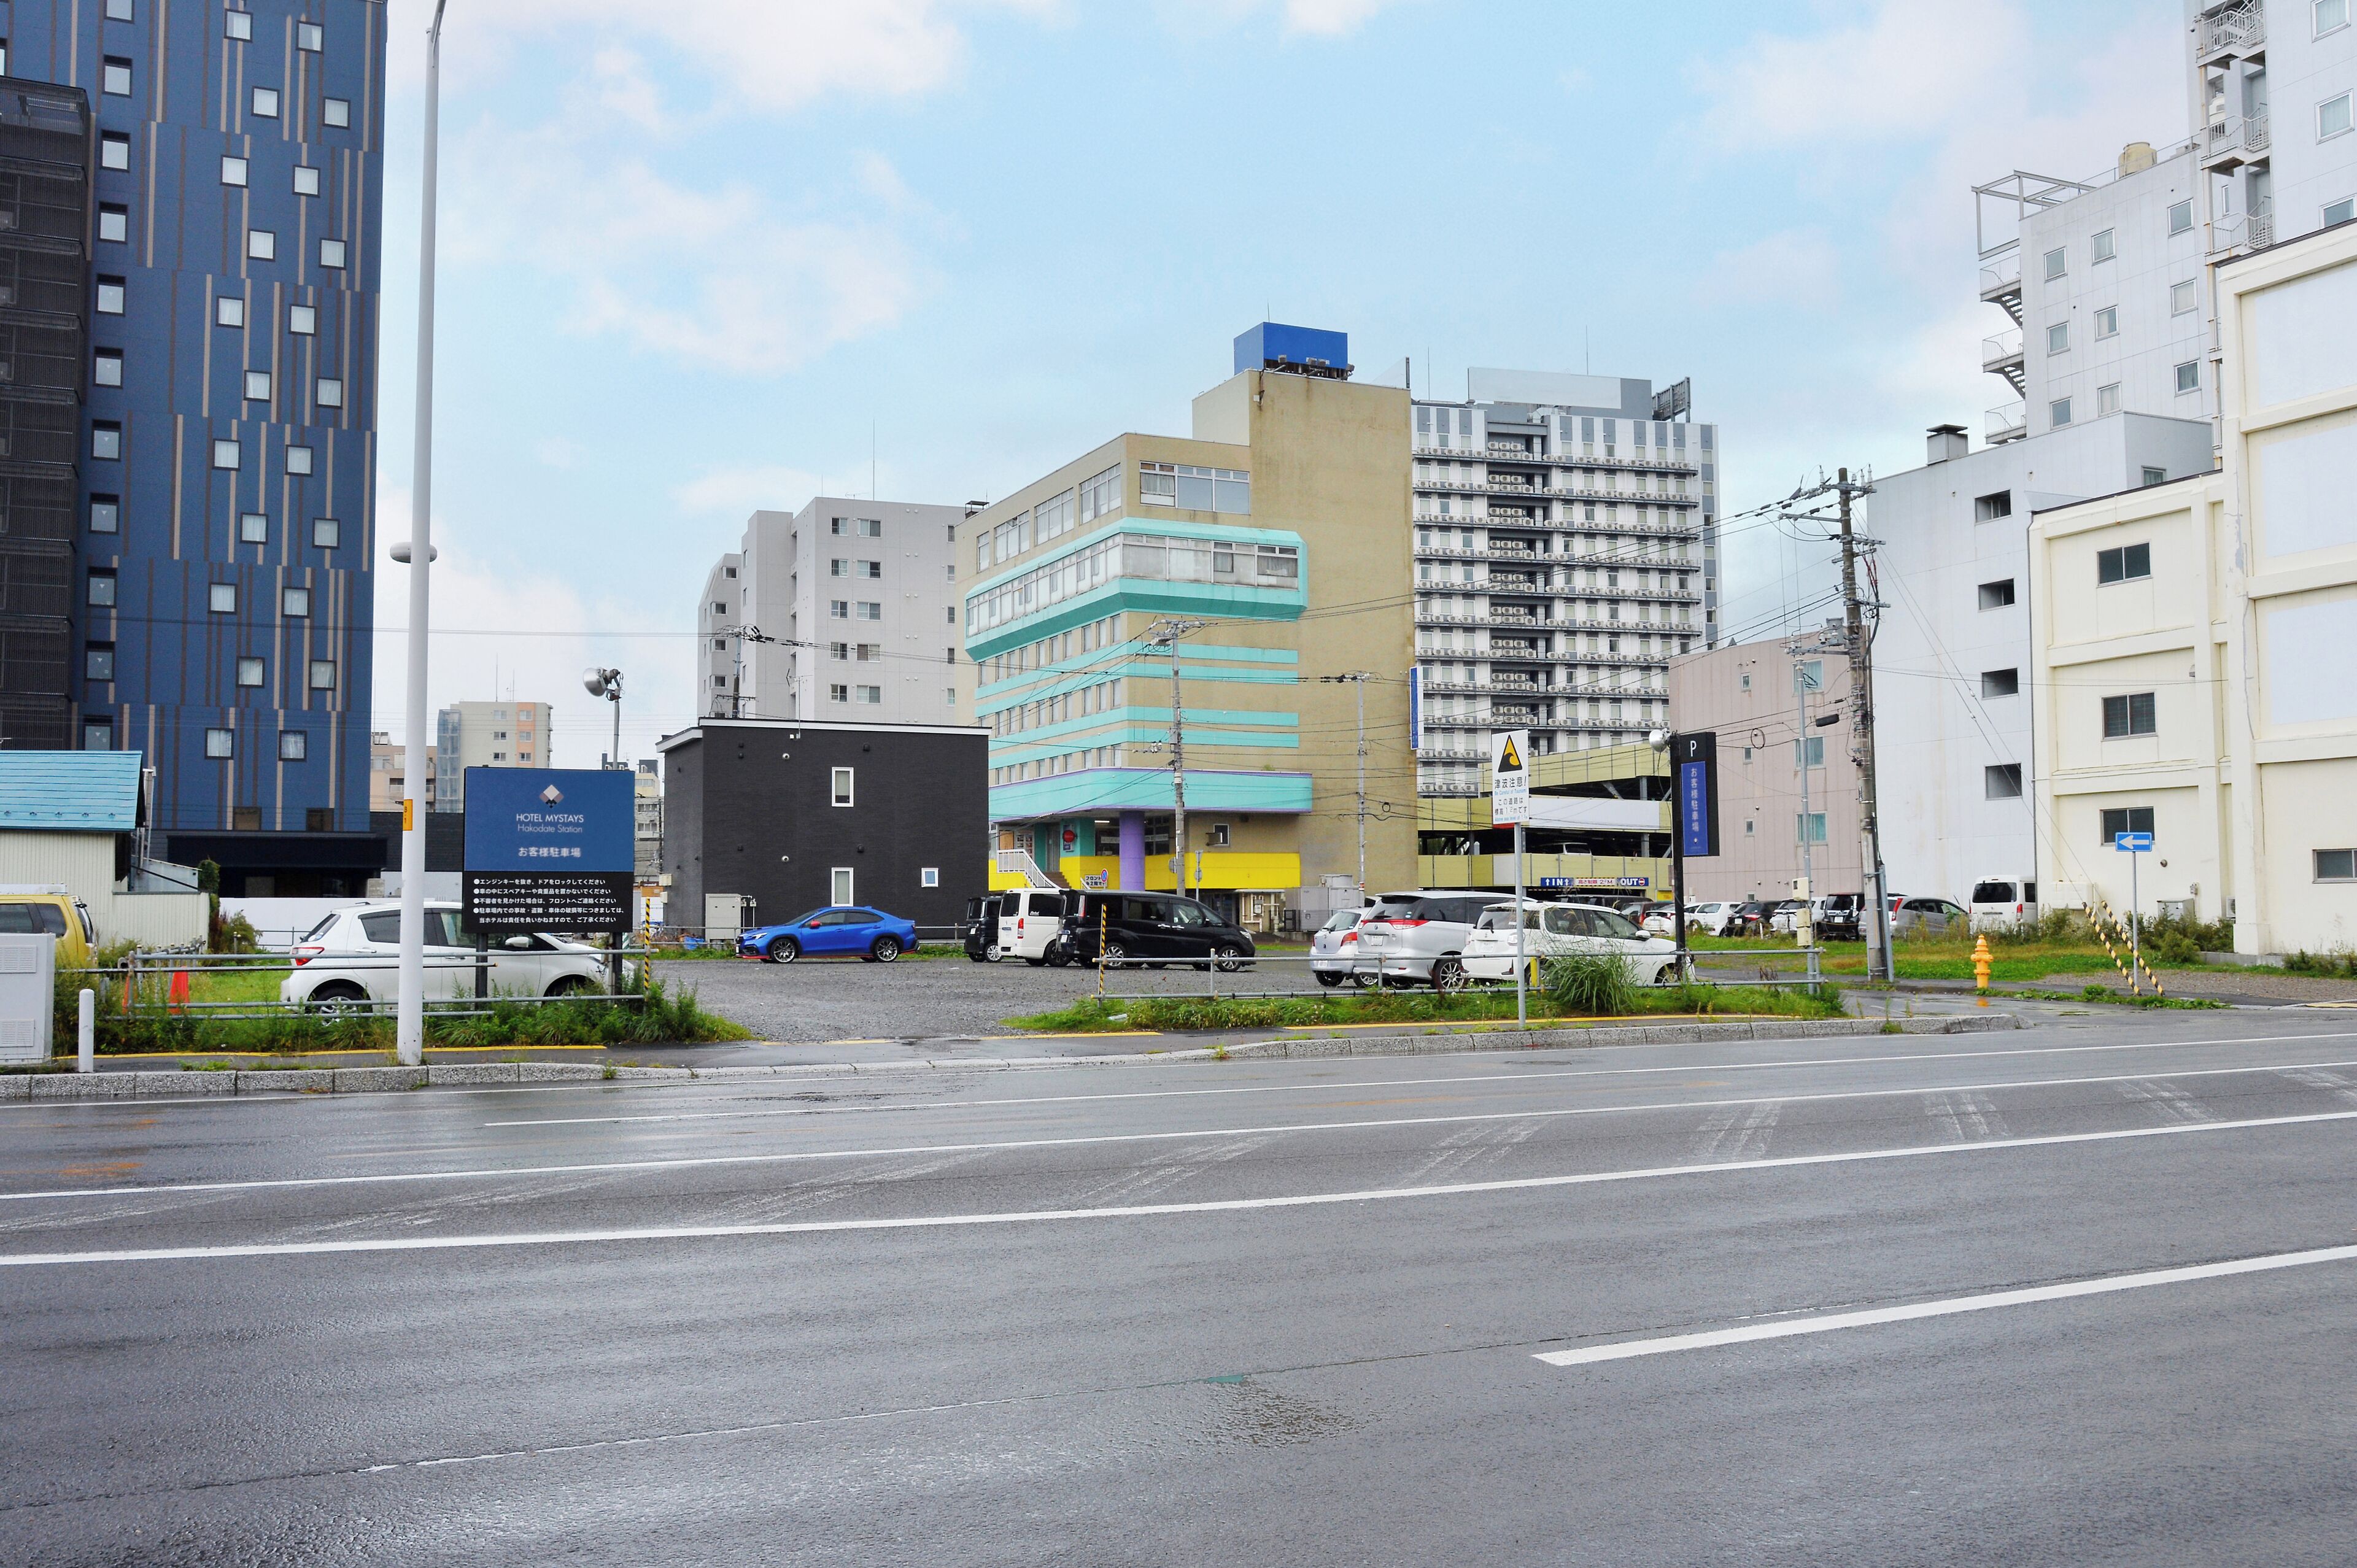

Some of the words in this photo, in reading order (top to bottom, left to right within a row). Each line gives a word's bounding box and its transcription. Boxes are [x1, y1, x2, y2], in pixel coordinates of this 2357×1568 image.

[1690, 740, 1697, 757] P
[1498, 797, 1523, 806] この道路は
[1690, 768, 1699, 832] お客様駐車場
[516, 813, 543, 822] HOTEL
[545, 814, 584, 823] MYSTAYS
[517, 823, 555, 833] Hakodate
[557, 824, 582, 833] Station
[518, 847, 581, 857] お客様駐車場
